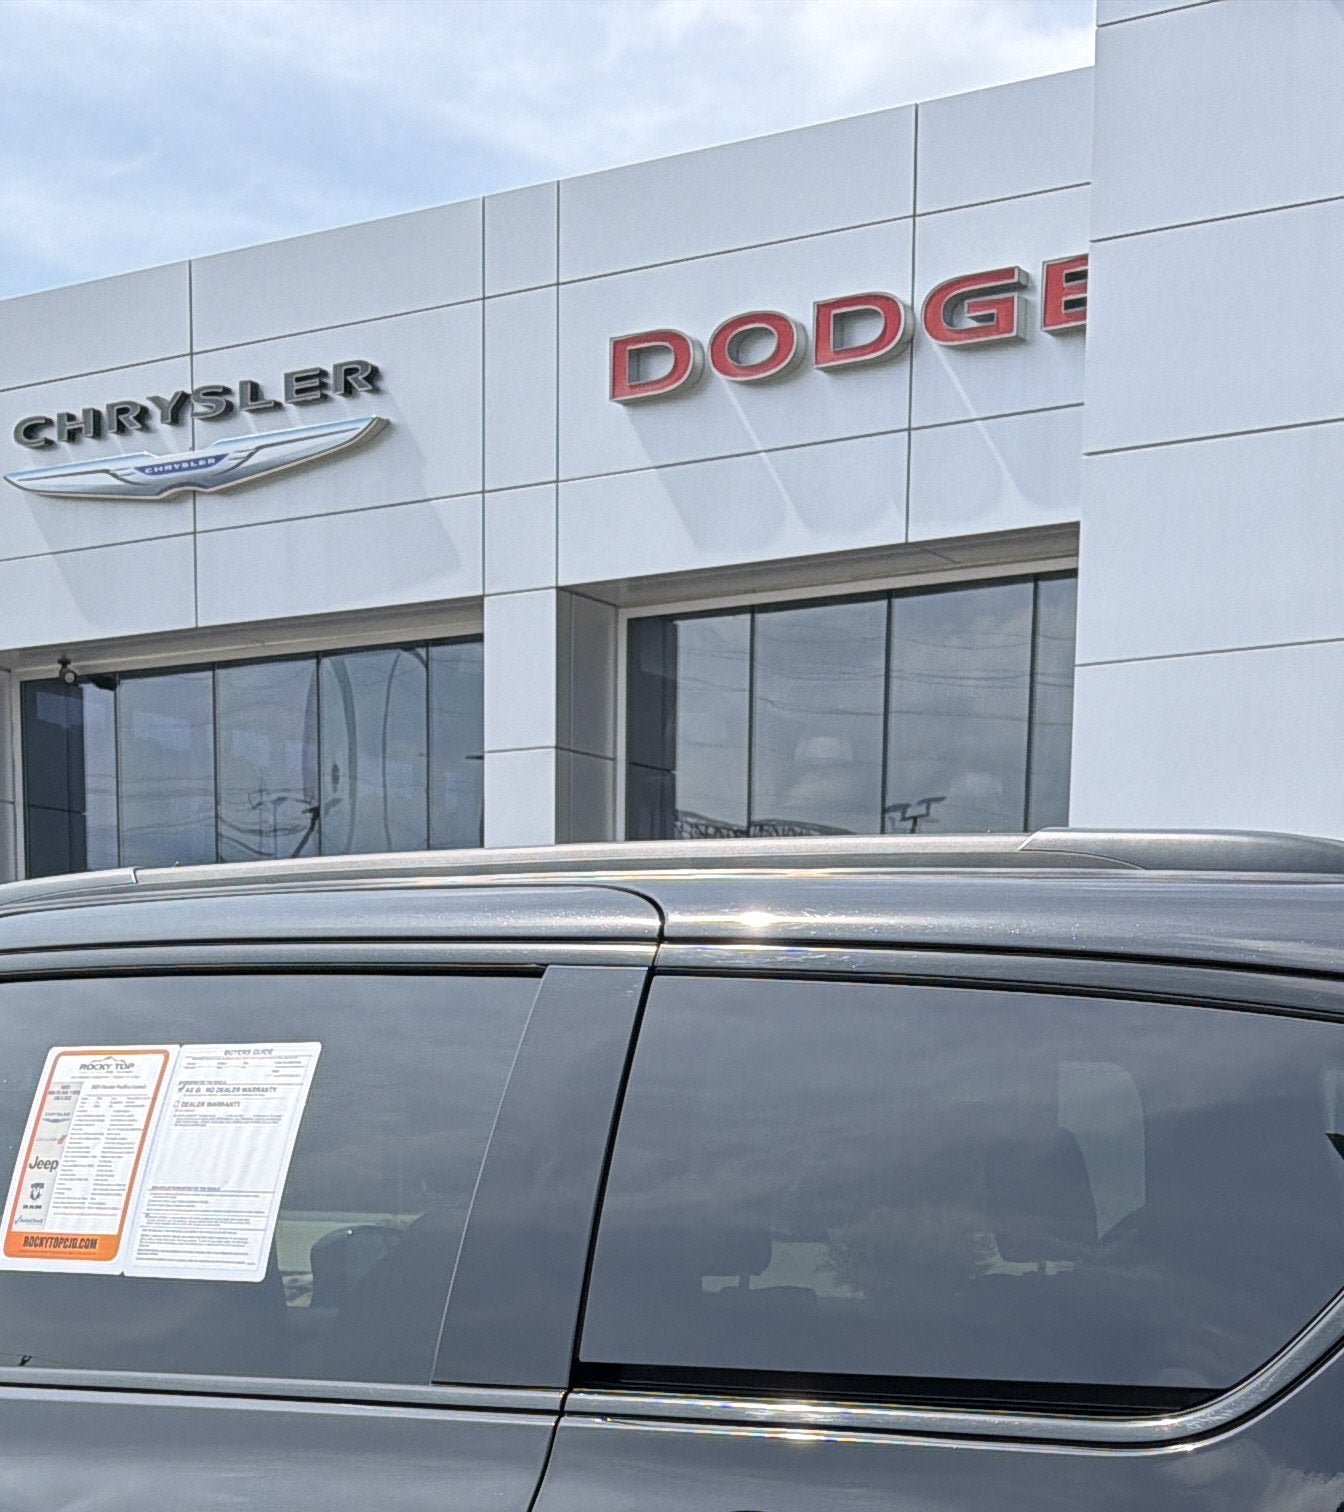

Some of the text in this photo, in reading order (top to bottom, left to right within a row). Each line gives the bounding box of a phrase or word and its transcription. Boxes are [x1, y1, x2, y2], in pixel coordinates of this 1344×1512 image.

[14, 359, 382, 449] CHRYSLER
[143, 457, 217, 475] CHRYSLER
[79, 1063, 111, 1071] ROCKY
[29, 1156, 59, 1172] Jeep
